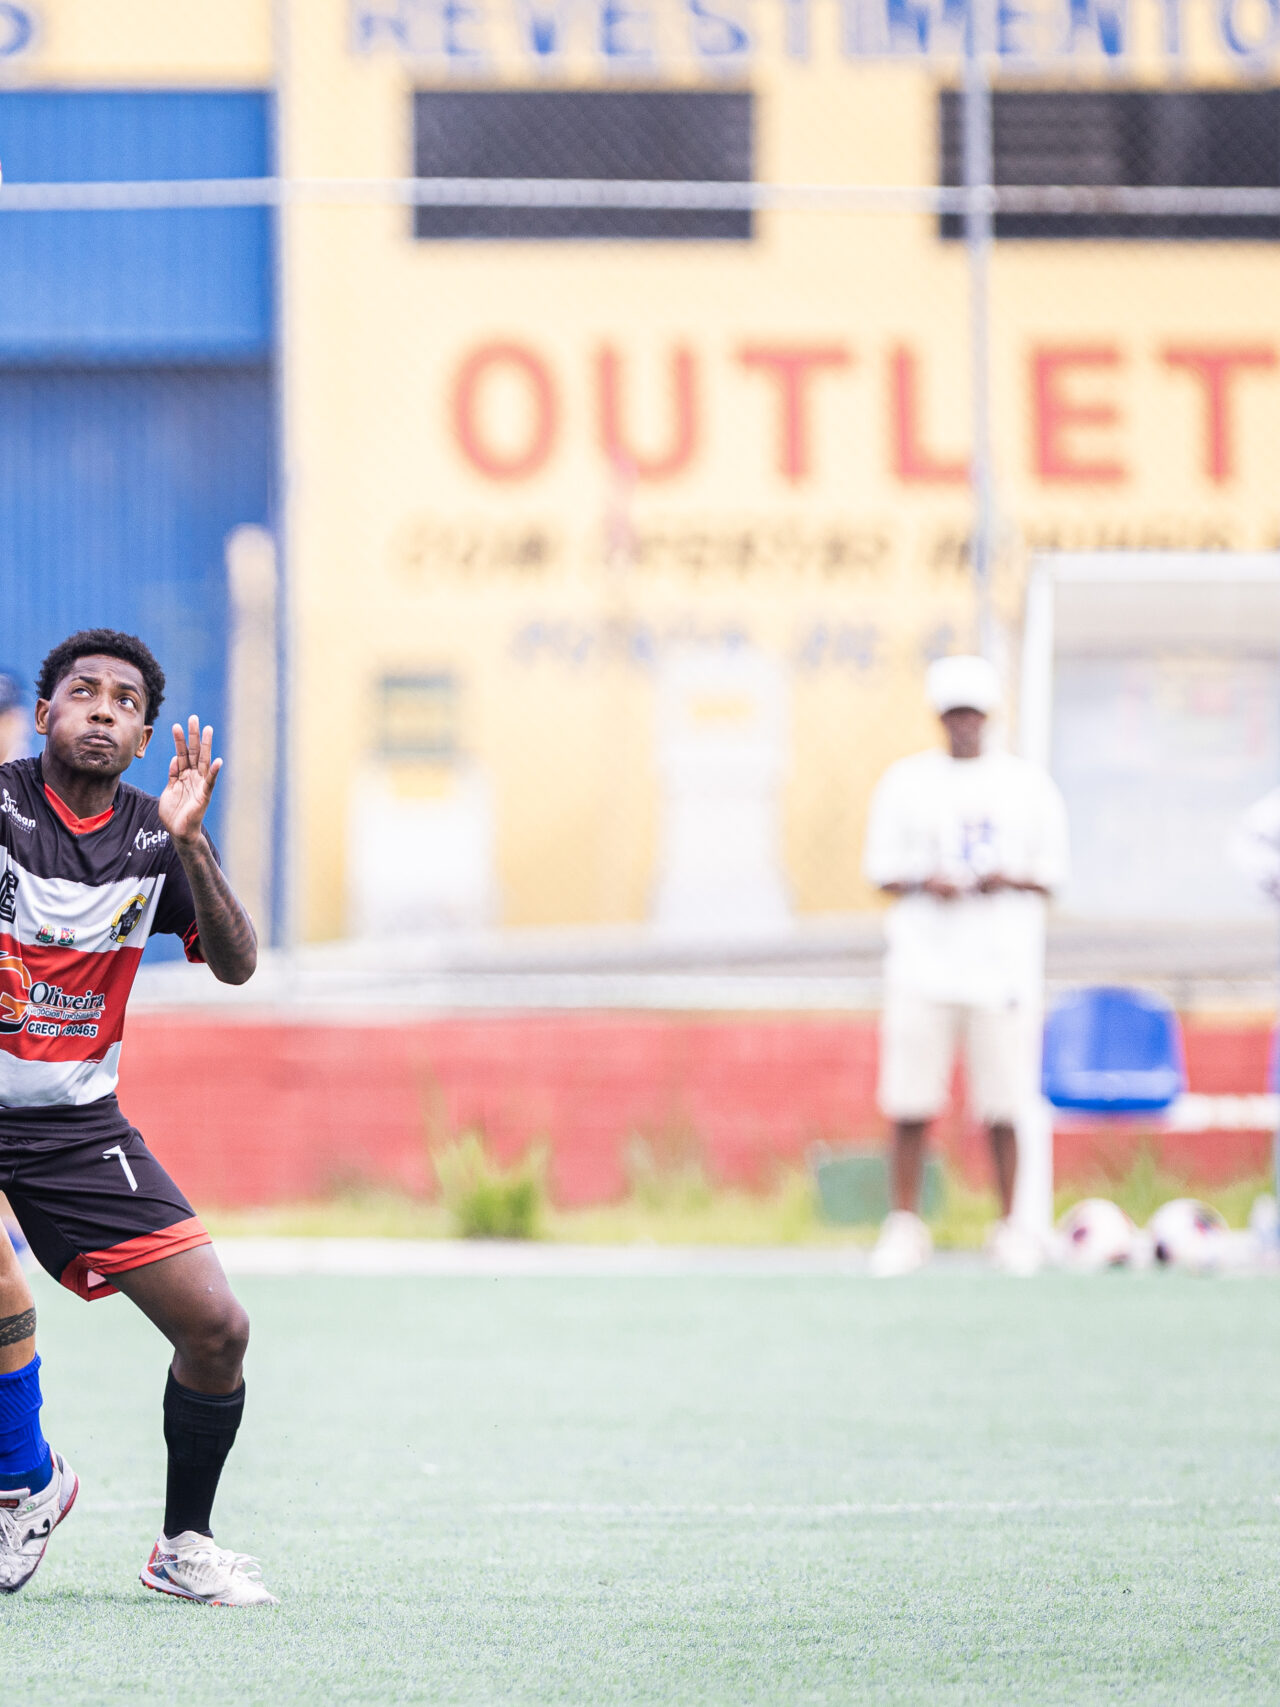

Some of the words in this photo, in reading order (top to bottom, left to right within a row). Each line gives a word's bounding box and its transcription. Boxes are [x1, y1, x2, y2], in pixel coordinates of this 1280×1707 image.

[448, 340, 1279, 487] OUTLET
[29, 981, 105, 1010] Oliveira
[27, 1022, 60, 1036] CRECI
